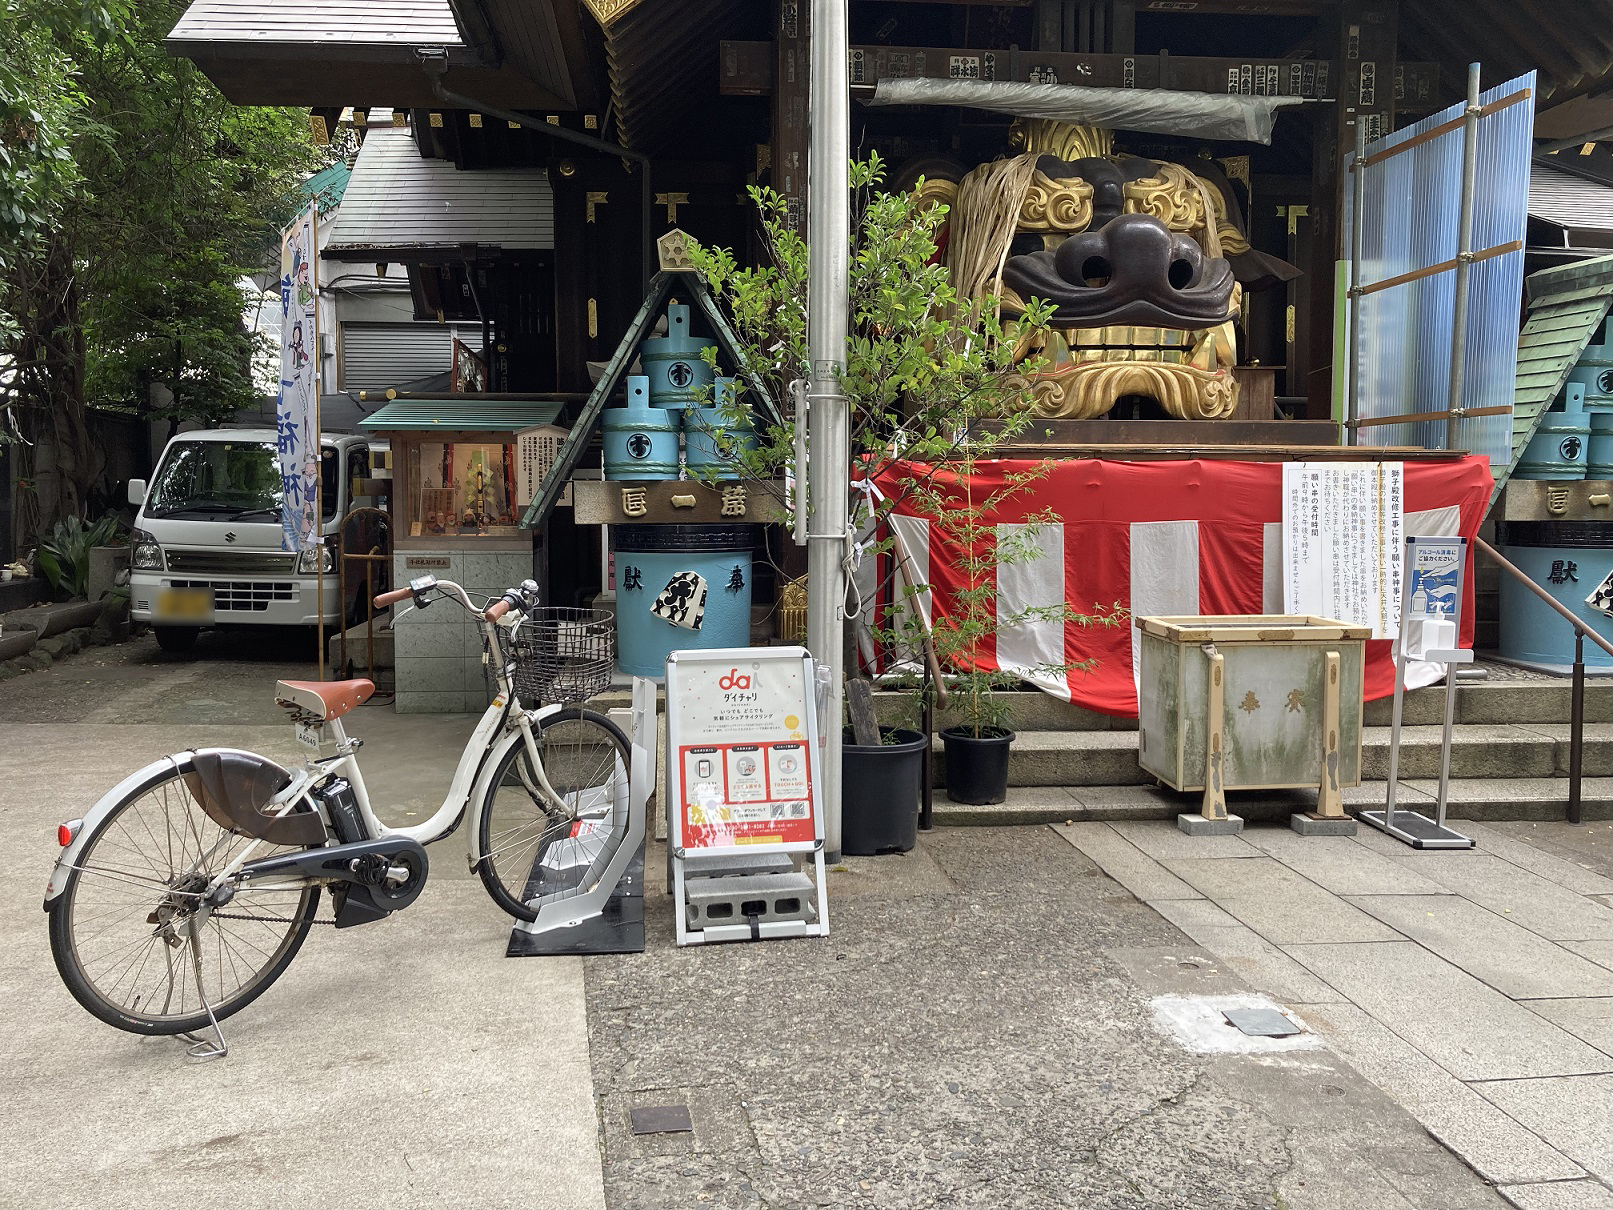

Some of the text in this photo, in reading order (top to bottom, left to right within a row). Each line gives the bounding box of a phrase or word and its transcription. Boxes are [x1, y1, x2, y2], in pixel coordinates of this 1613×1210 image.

[1291, 489, 1300, 615] 時間外でのお預かりは出来ませんご了承く
[1311, 473, 1319, 537] 願い串の受付時間
[1351, 470, 1360, 625] 「願い串」の奉納神事につきましては神社でお預か
[1391, 470, 1401, 629] 獅子殿改修工事に伴う願い串神事について
[713, 713, 774, 722] 気軽にシェアサイクリング
[723, 692, 757, 703] ダイチャリ
